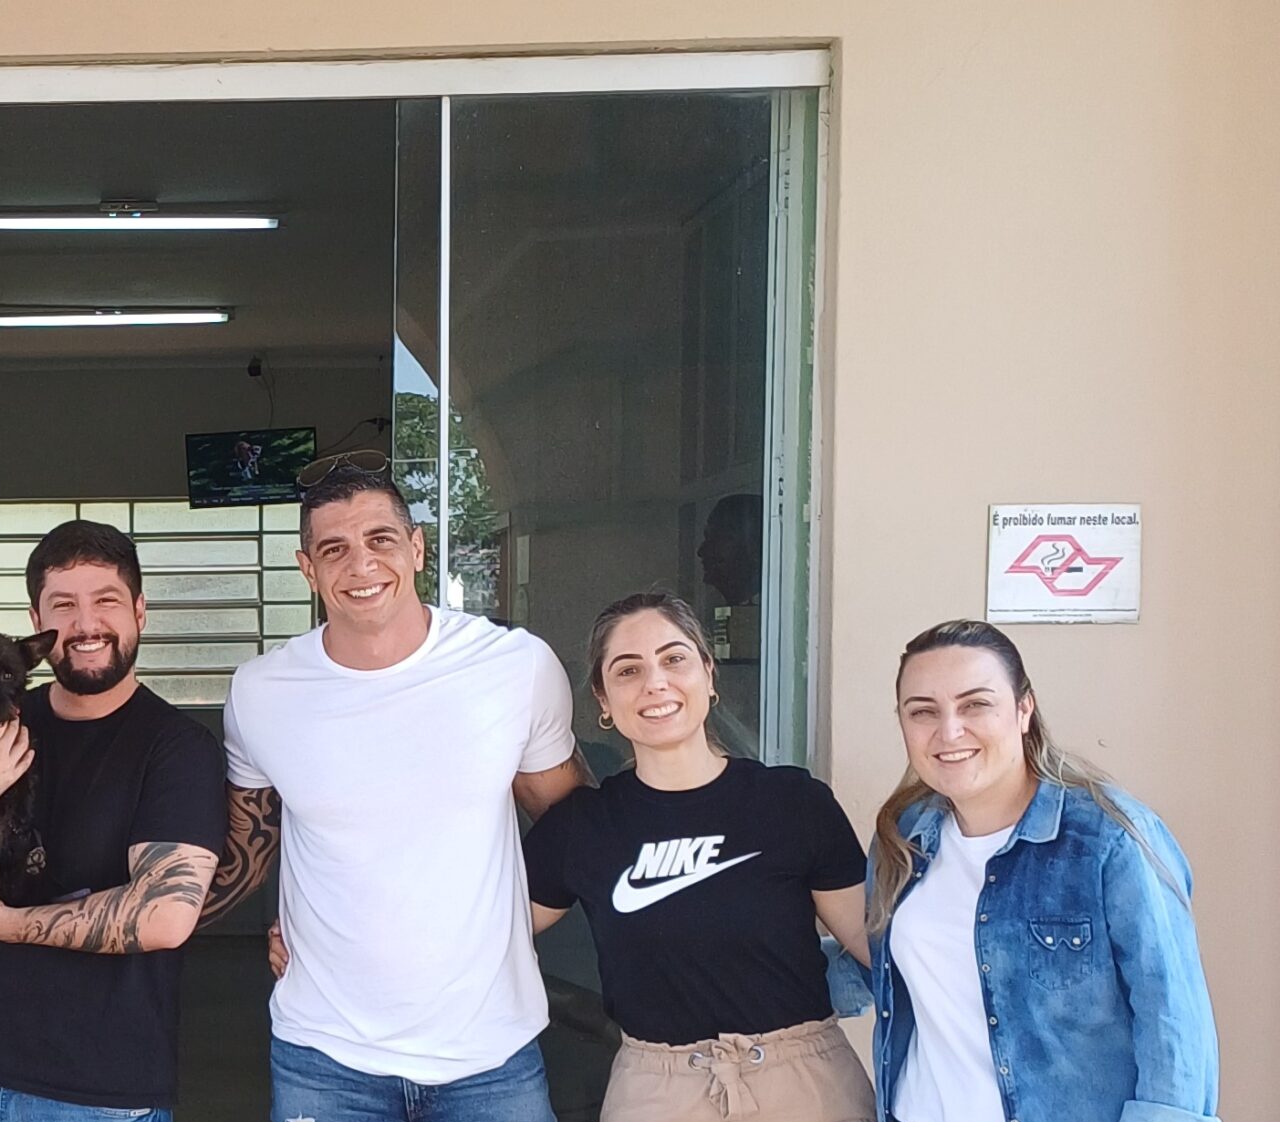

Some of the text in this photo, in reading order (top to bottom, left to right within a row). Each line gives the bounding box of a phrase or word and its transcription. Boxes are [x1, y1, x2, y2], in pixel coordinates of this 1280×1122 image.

[1002, 512, 1044, 529] proibido
[1046, 512, 1076, 526] fumar
[1079, 512, 1108, 526] neste
[1111, 511, 1139, 526] local.
[629, 835, 726, 880] NIKE
